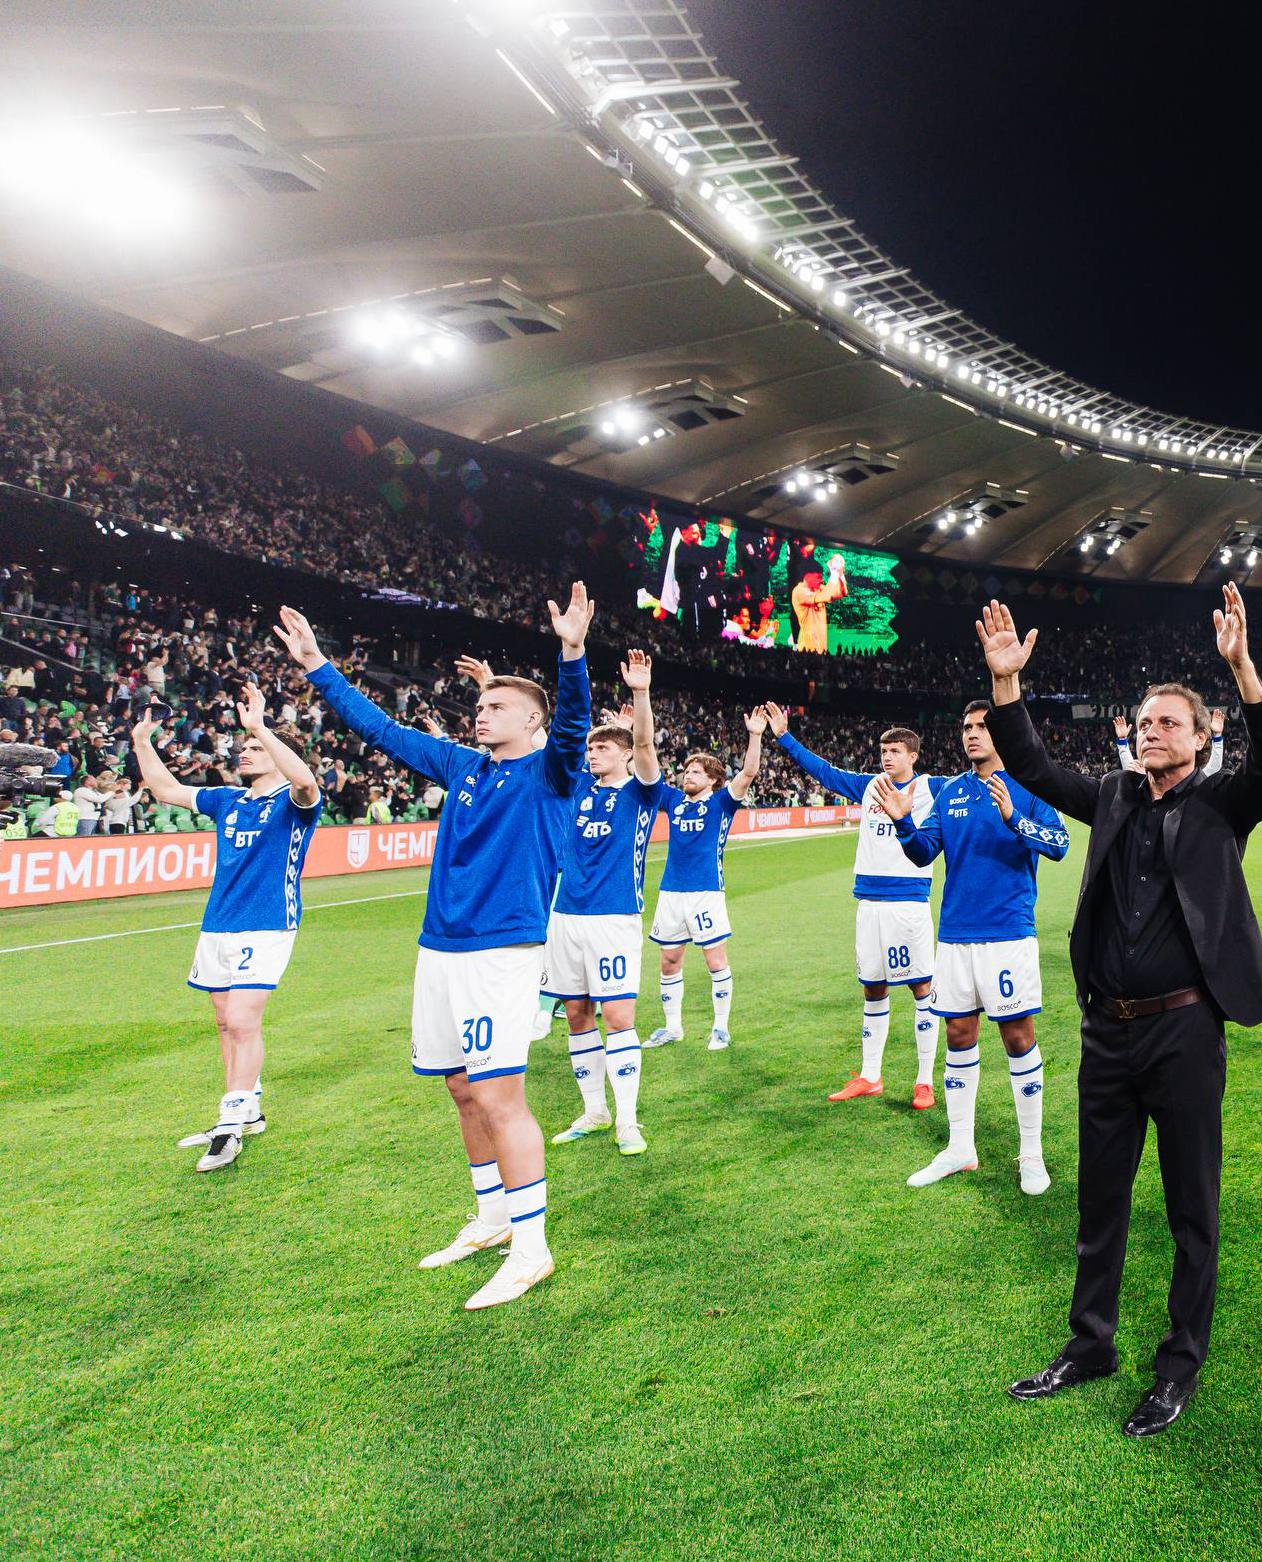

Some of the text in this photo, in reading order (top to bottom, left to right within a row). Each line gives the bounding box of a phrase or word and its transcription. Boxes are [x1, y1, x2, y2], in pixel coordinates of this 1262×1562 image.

[954, 808, 968, 818] ВТБ
[582, 821, 612, 838] ВТБ
[680, 819, 705, 832] ВТБ
[876, 823, 895, 836] ВТ
[378, 830, 439, 861] ЧЕМП
[0, 843, 218, 895] ЧЕМПИОН
[694, 911, 713, 931] 15
[238, 947, 253, 970] 2
[599, 955, 626, 981] 60
[887, 945, 911, 969] 88
[998, 969, 1014, 998] 6
[461, 1015, 493, 1055] 30
